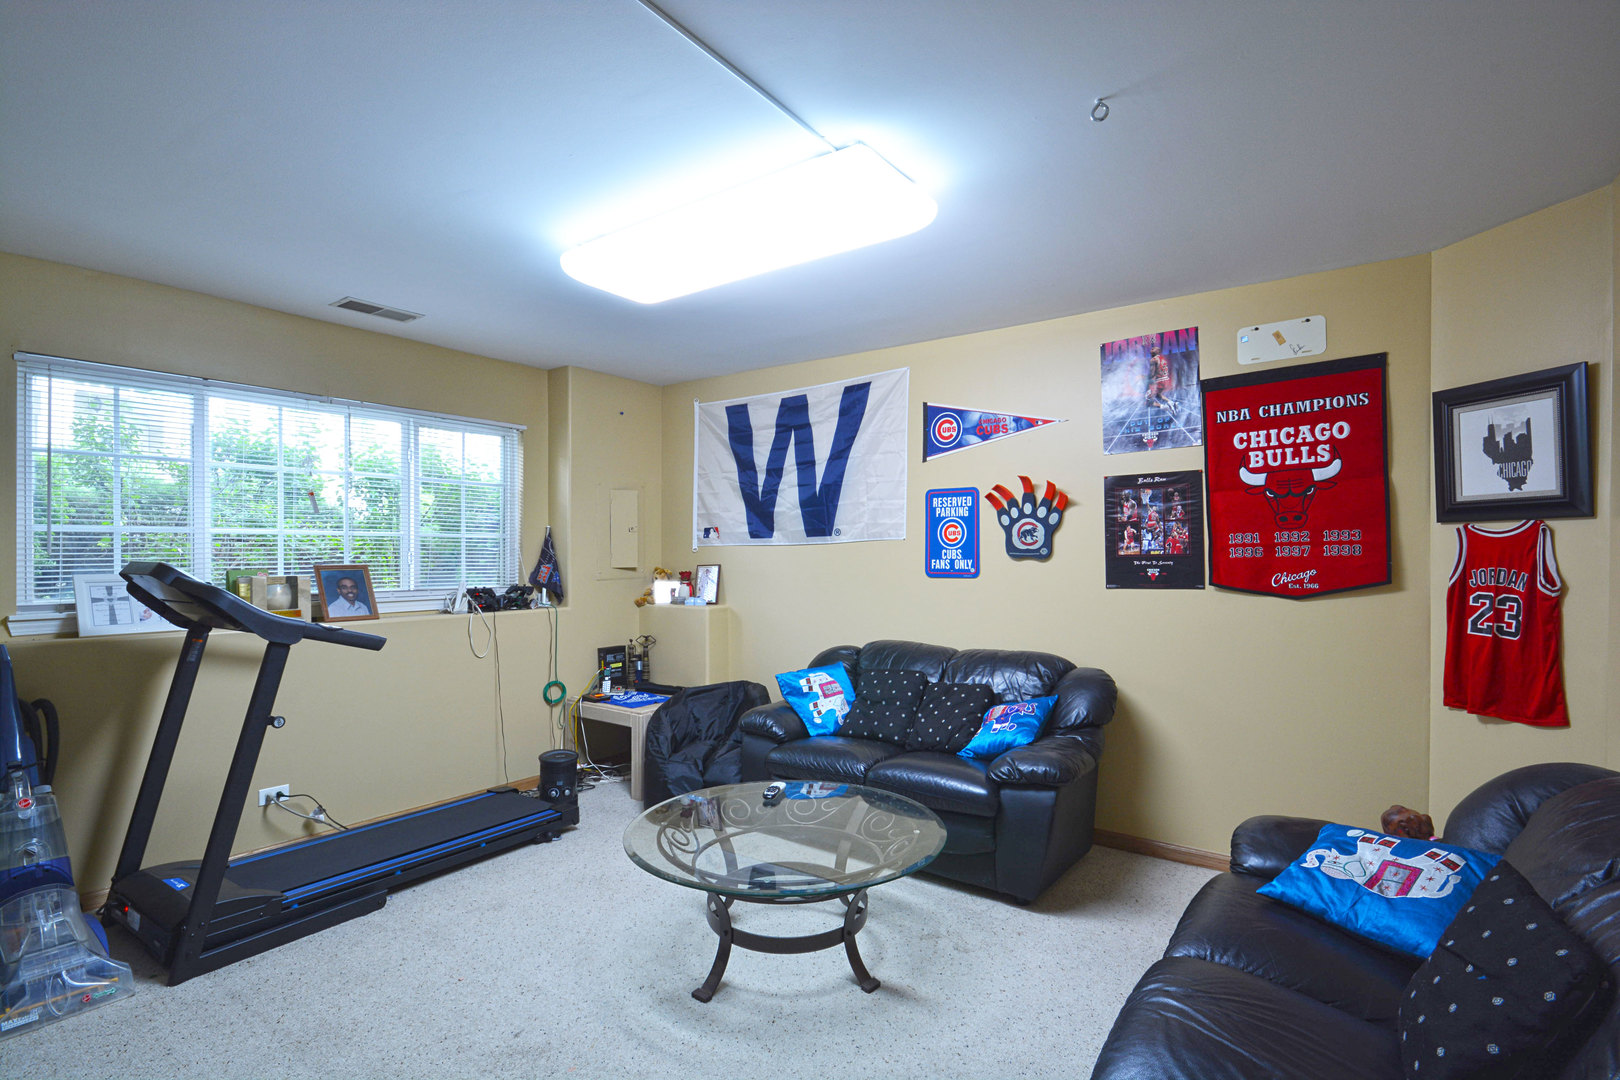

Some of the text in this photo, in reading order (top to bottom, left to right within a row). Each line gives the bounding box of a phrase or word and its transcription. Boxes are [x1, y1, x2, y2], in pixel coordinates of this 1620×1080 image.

[1103, 327, 1197, 365] JORDAN
[1216, 392, 1370, 423] NBA CHAMPIONS
[976, 424, 1009, 436] CUBS
[978, 417, 1007, 425] CHICAGO
[1233, 421, 1351, 449] CHICAGO
[725, 381, 872, 539] W
[1249, 444, 1331, 468] BULLS
[1498, 460, 1532, 479] CHICAGO
[933, 496, 972, 507] RESERVED
[936, 506, 969, 518] PARKING
[1228, 529, 1361, 544] 1991 1992 1993
[941, 549, 962, 560] CUBS
[1229, 544, 1362, 558] 1996 1997 1998
[931, 559, 973, 570] FANS ONLY
[1271, 568, 1317, 587] Chicago
[1469, 568, 1529, 592] JORDAN
[1467, 592, 1522, 640] 23
